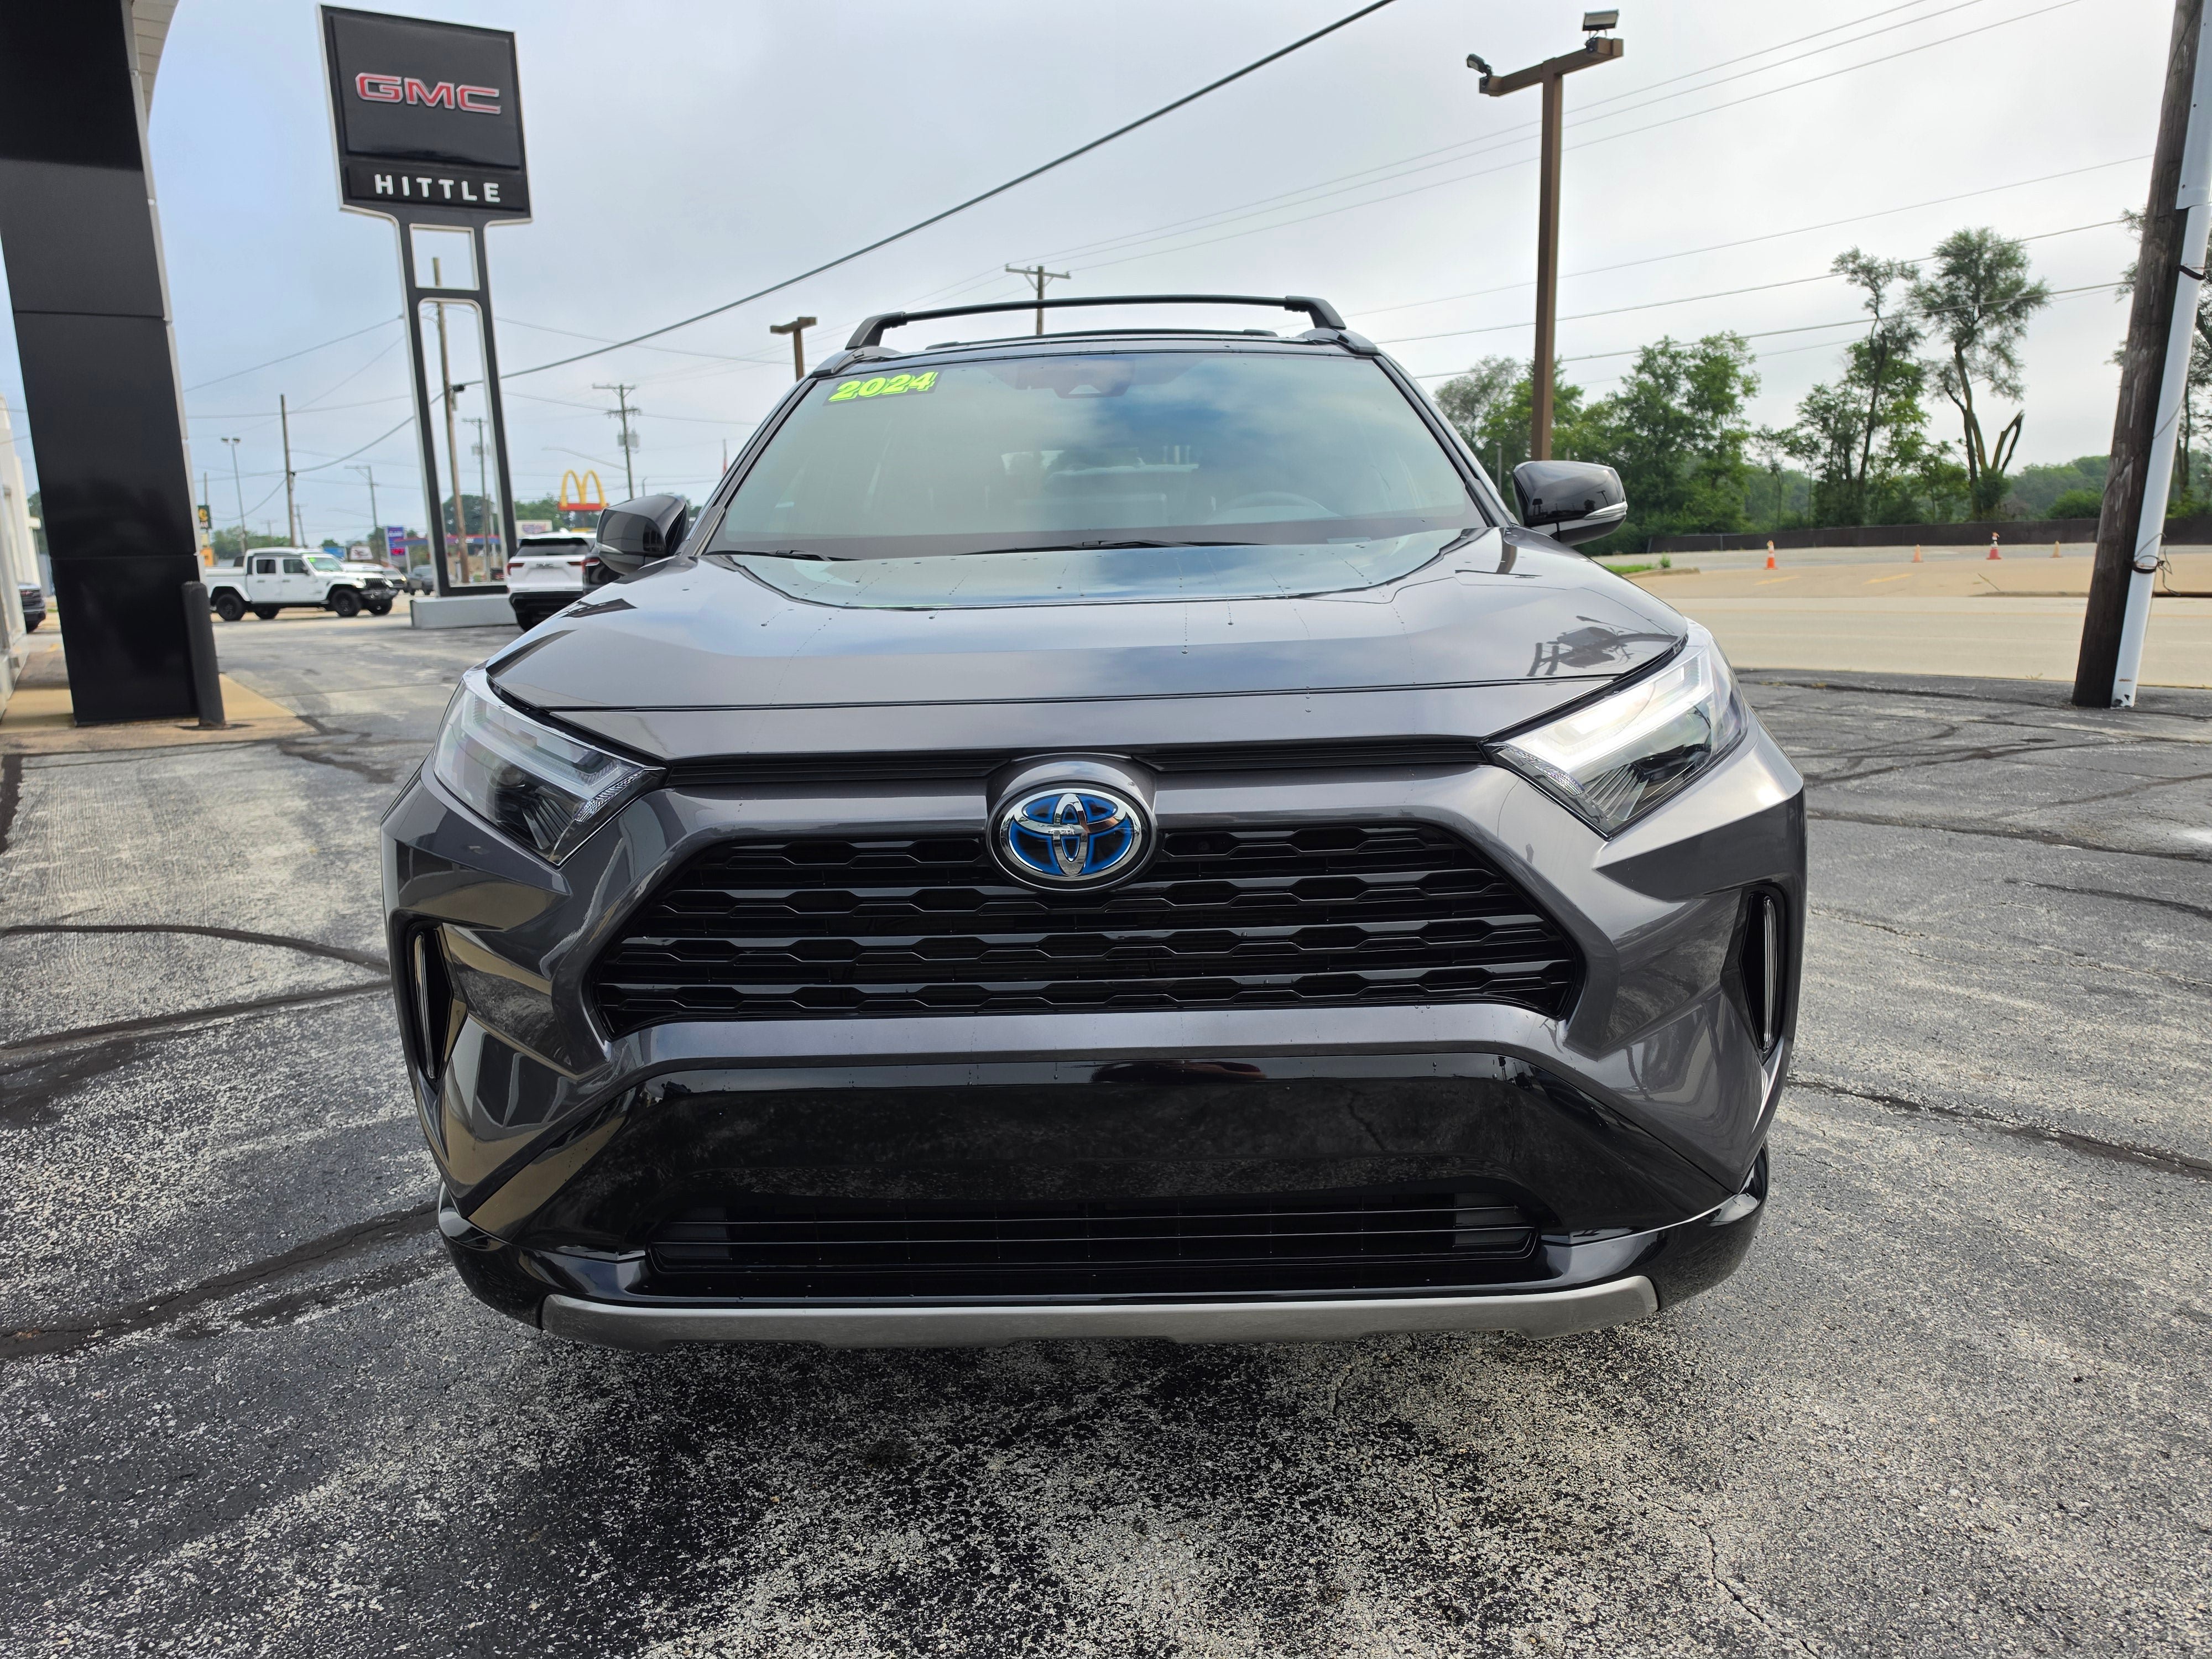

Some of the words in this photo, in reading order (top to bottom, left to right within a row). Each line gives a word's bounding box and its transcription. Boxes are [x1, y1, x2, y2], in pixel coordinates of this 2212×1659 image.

[356, 72, 501, 114] GMC
[374, 174, 500, 203] HITTLE
[828, 371, 938, 402] 2024
